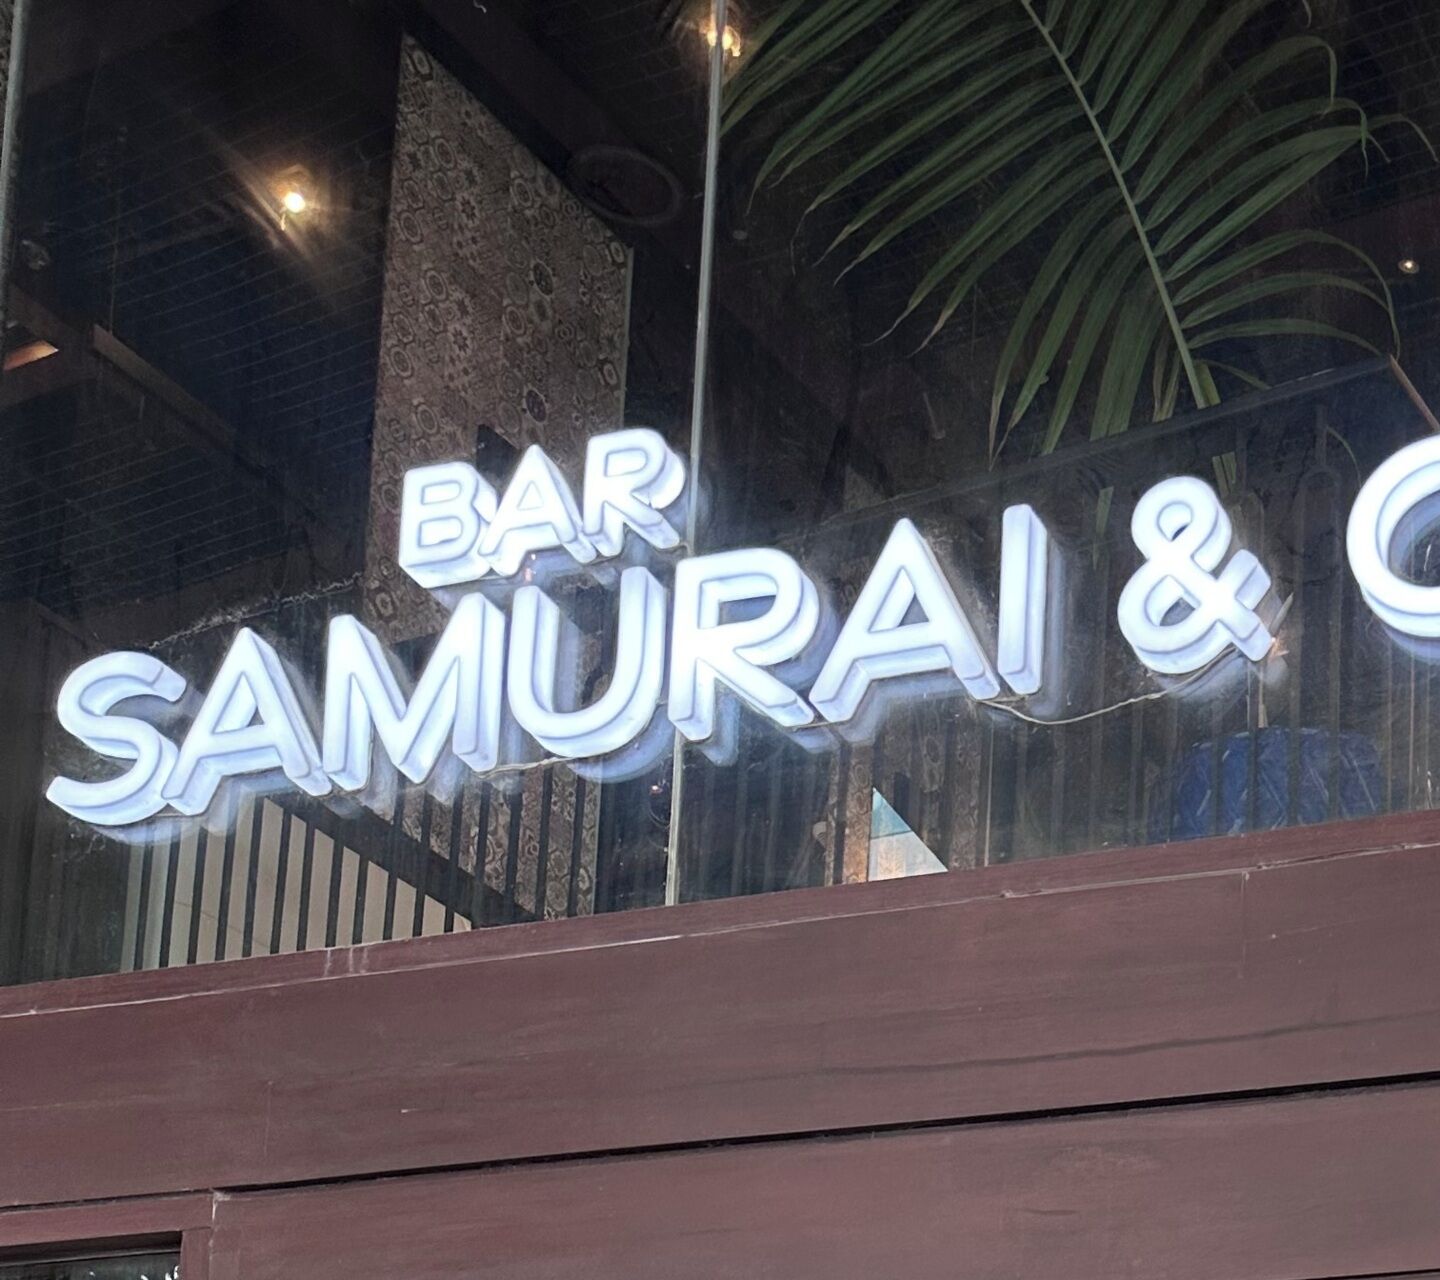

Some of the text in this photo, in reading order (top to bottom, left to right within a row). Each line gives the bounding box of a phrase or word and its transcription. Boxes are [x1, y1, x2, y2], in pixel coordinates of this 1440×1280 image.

[401, 428, 686, 588] BAR
[46, 505, 1058, 828] SAMURAI
[1118, 474, 1274, 678] &
